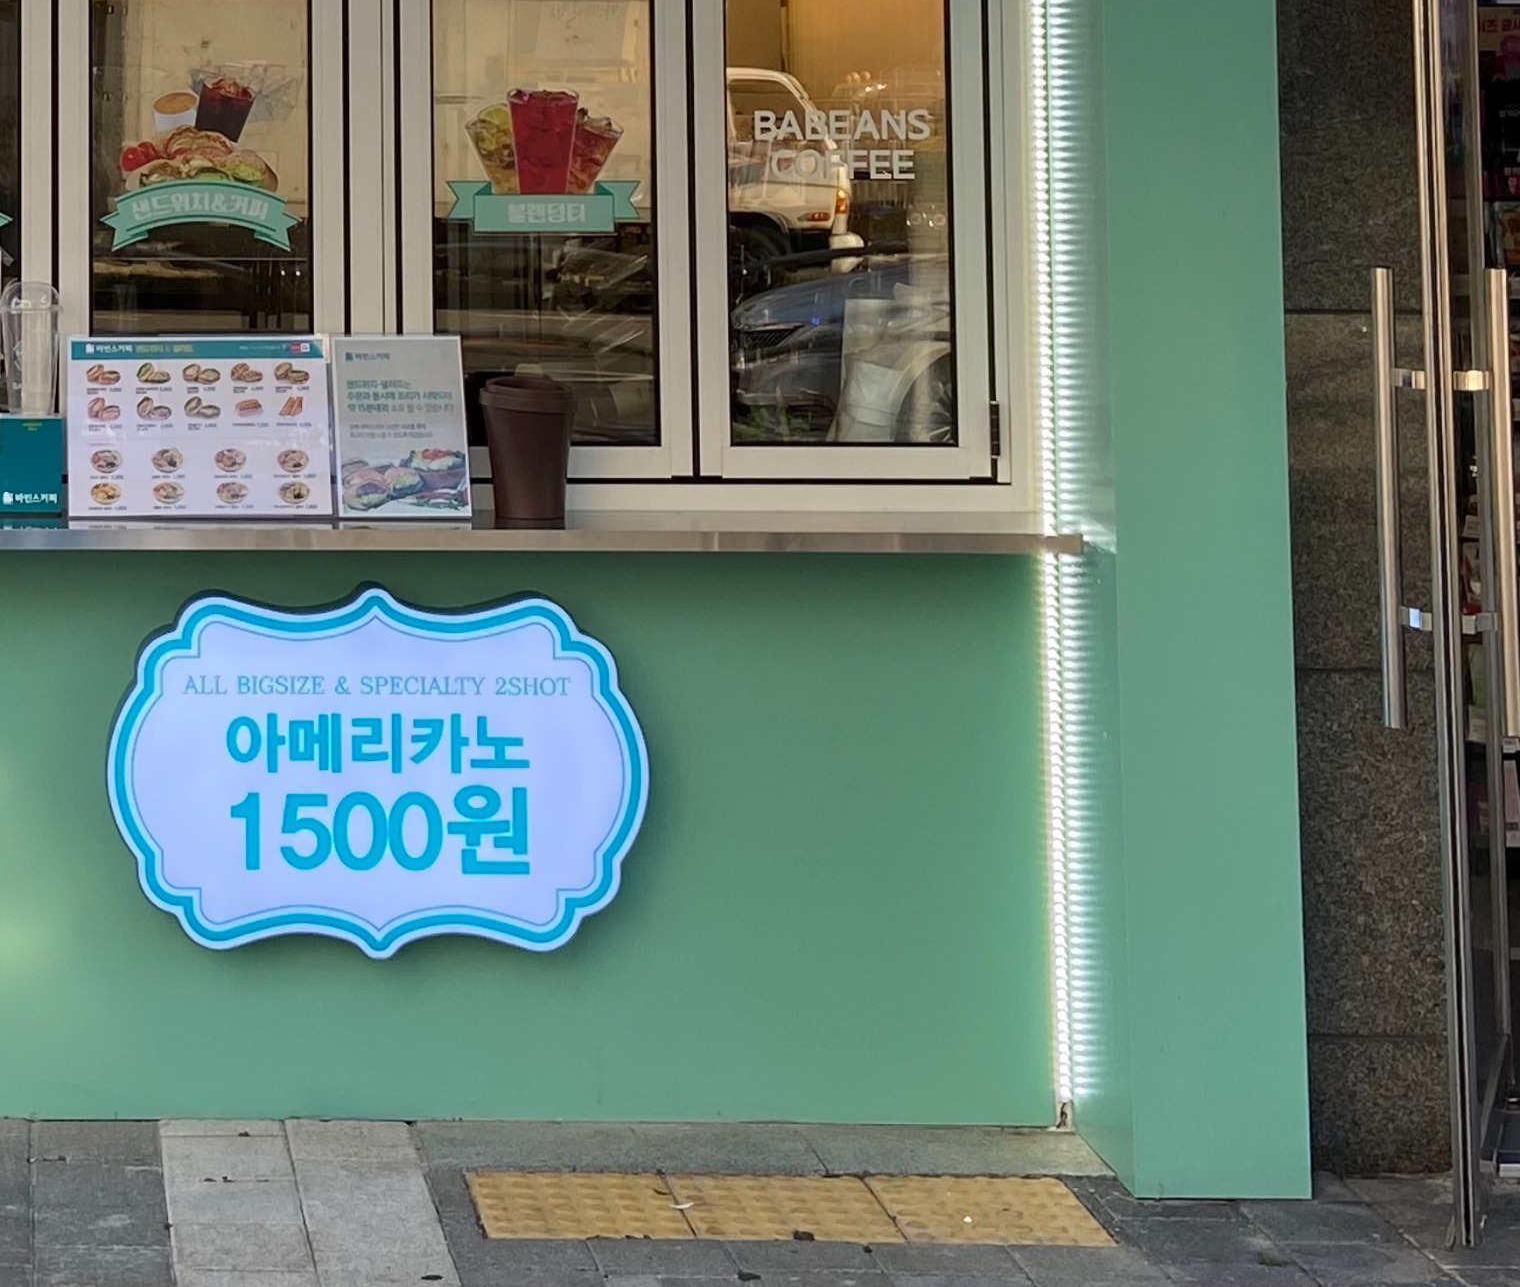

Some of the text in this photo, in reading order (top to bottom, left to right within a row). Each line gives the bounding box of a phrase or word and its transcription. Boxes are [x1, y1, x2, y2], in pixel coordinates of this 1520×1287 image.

[753, 109, 931, 141] BABEANS
[770, 149, 916, 181] COFFEE
[182, 675, 572, 697] ALL BIGSIZE & SPECIALTY 2SHOT
[226, 712, 531, 773] 아메리카노
[229, 785, 531, 875] 1500원
